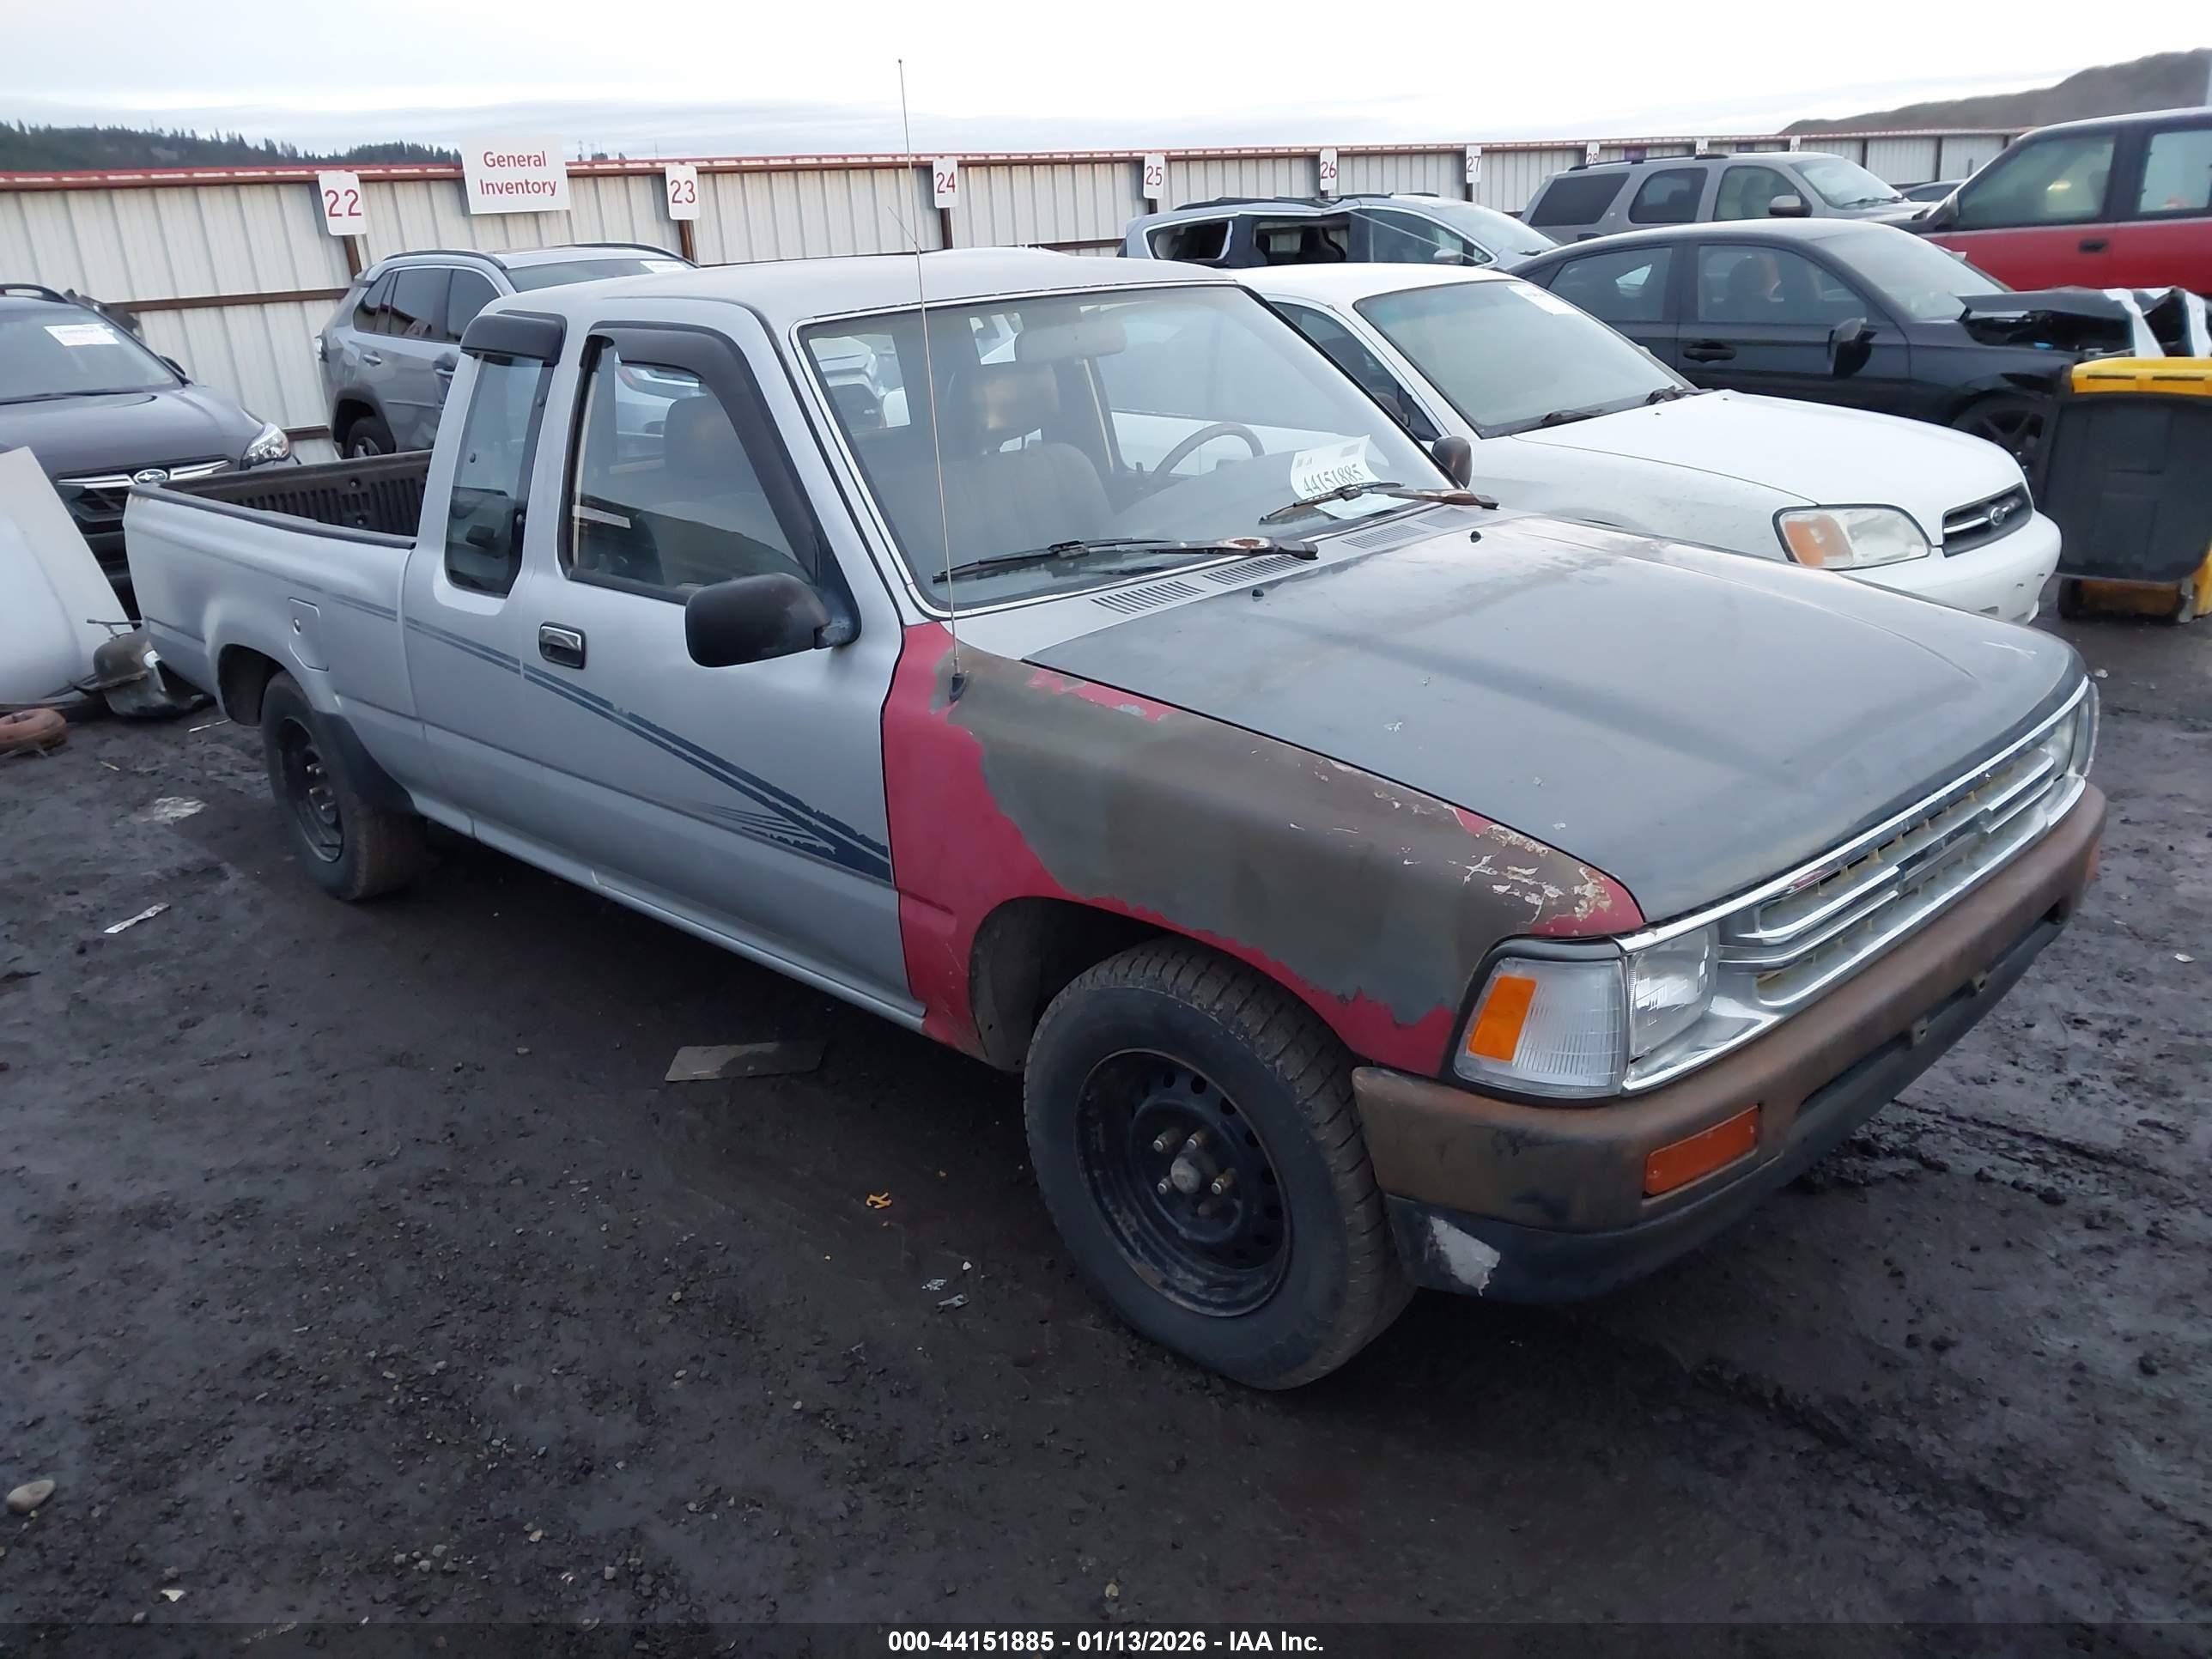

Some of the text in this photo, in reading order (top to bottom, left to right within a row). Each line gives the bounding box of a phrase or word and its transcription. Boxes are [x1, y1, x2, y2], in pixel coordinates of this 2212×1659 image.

[483, 150, 547, 168] General
[1466, 155, 1481, 173] 27
[1146, 166, 1163, 186] 25
[1321, 161, 1337, 179] 26
[479, 178, 557, 198] Inventory
[670, 179, 696, 204] 23
[936, 172, 956, 194] 24
[325, 188, 362, 217] 22
[1304, 463, 1364, 495] 44151885
